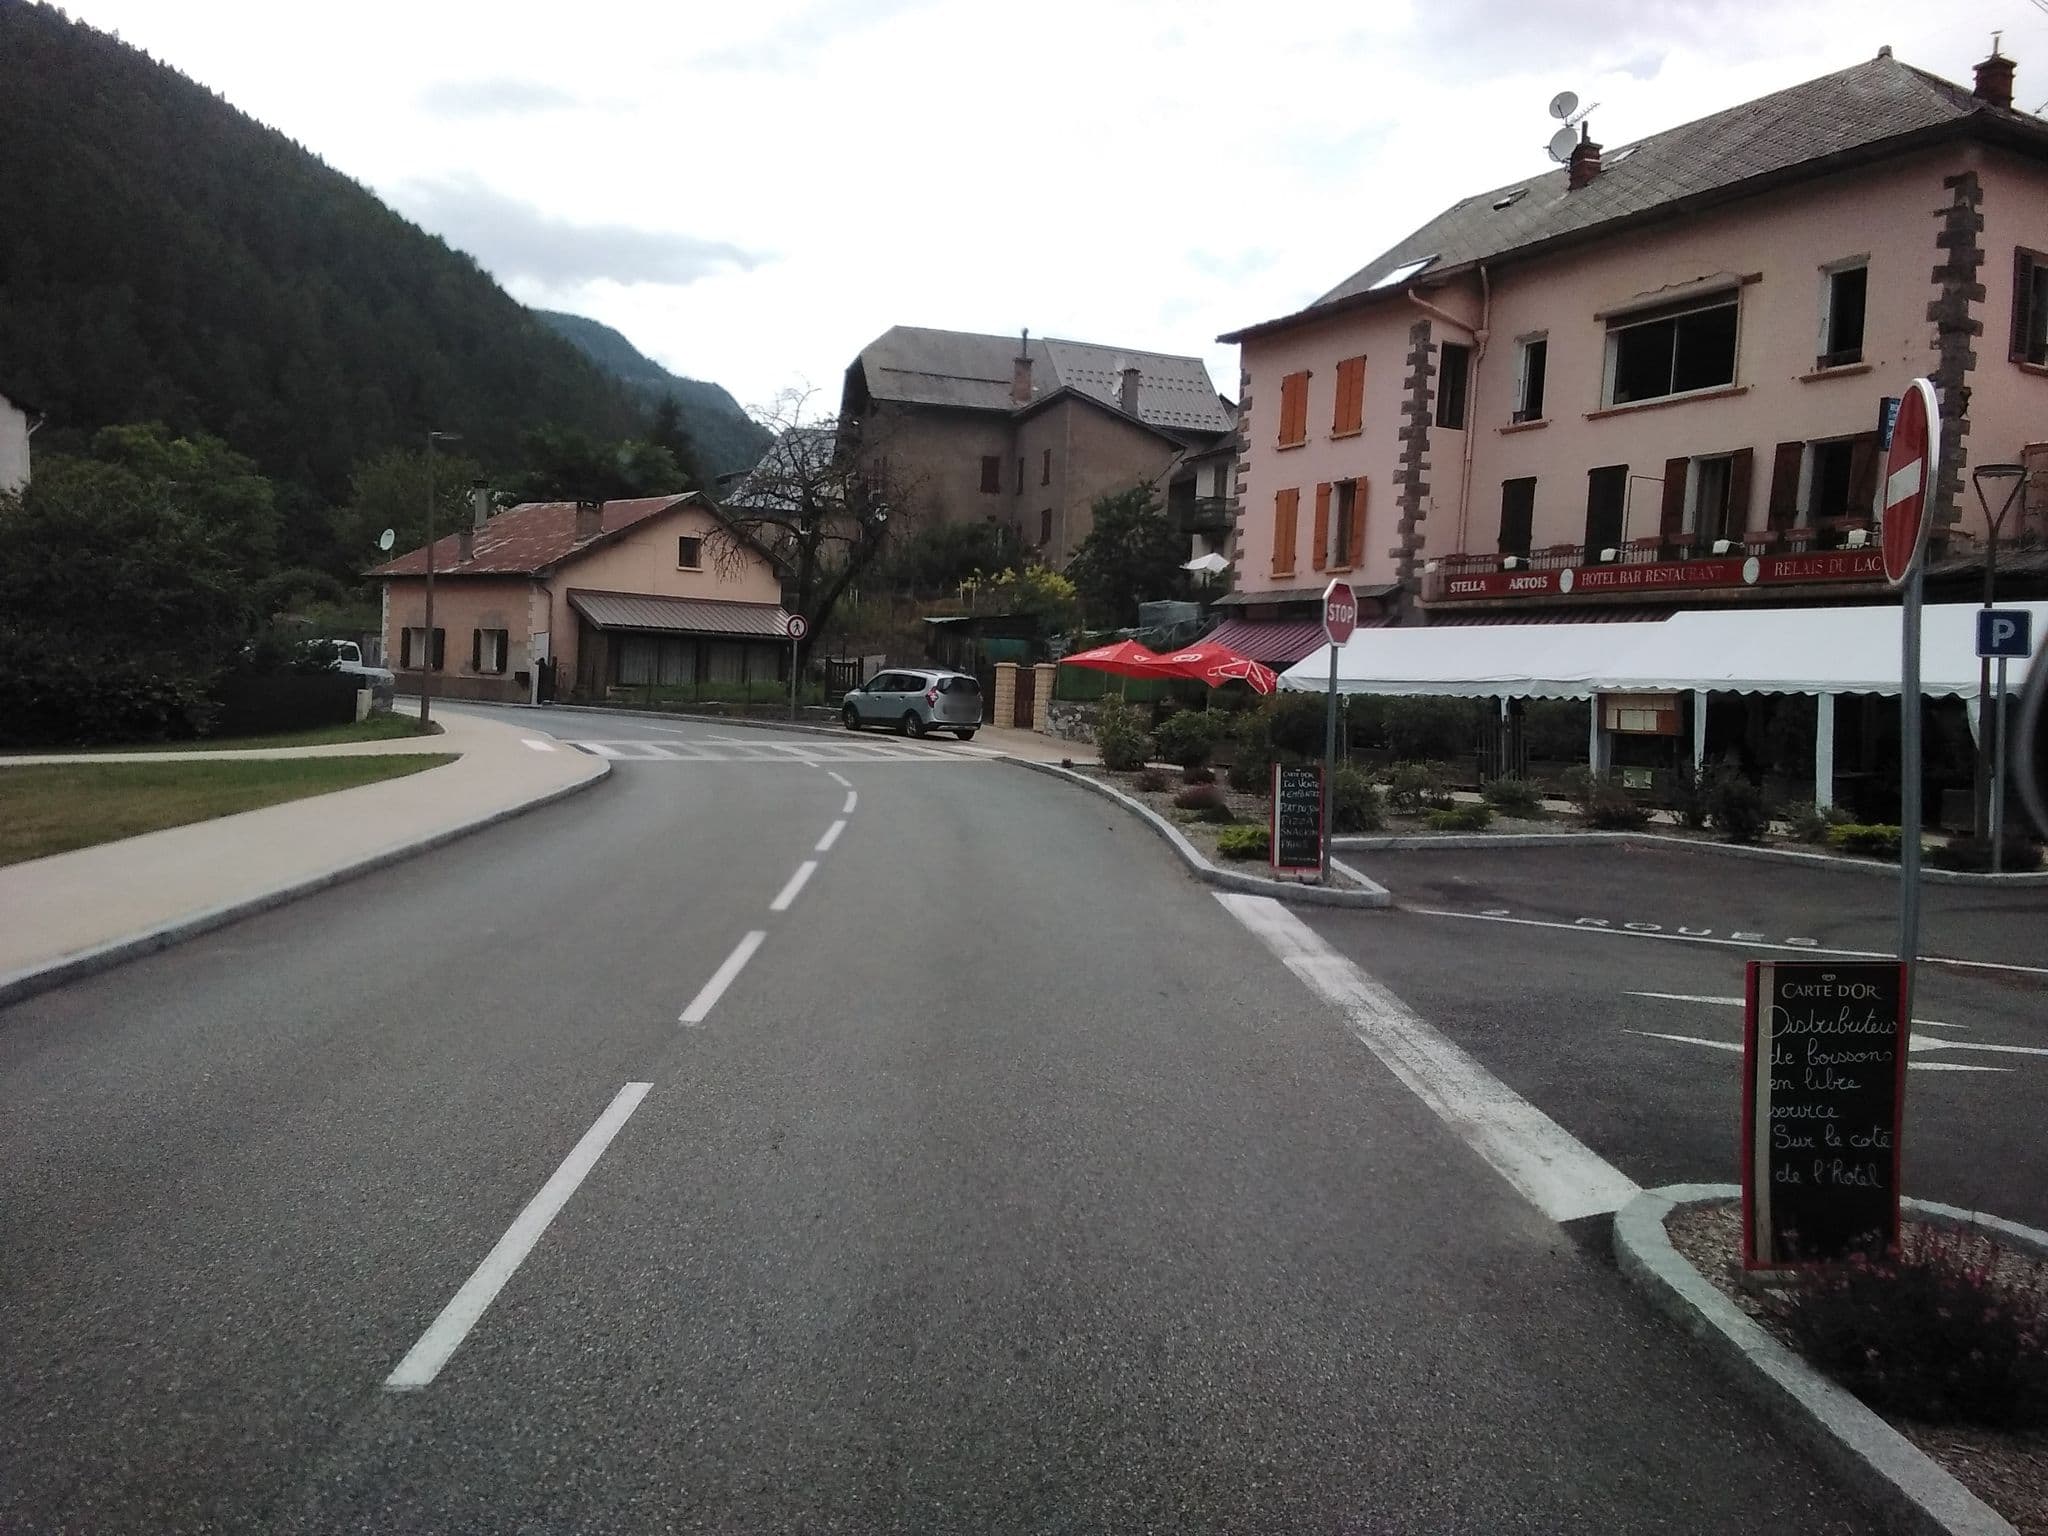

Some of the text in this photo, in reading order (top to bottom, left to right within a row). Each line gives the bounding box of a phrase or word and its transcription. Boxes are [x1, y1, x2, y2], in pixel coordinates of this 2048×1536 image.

[1774, 556, 1882, 577] RELAIS DU LAC
[1449, 576, 1548, 593] STELLA ARTOIS
[1581, 572, 1617, 586] HOTEL
[1620, 570, 1642, 584] BAR
[1328, 603, 1354, 623] STOP
[1992, 618, 2016, 648] P
[1781, 983, 1882, 999] CARTE D'OR
[1769, 1043, 1795, 1065] de
[1769, 1067, 1862, 1090] en libre
[1767, 1104, 1840, 1119] service
[1773, 1124, 1816, 1149] Sur
[1825, 1123, 1843, 1147] le
[1775, 1163, 1801, 1183] de
